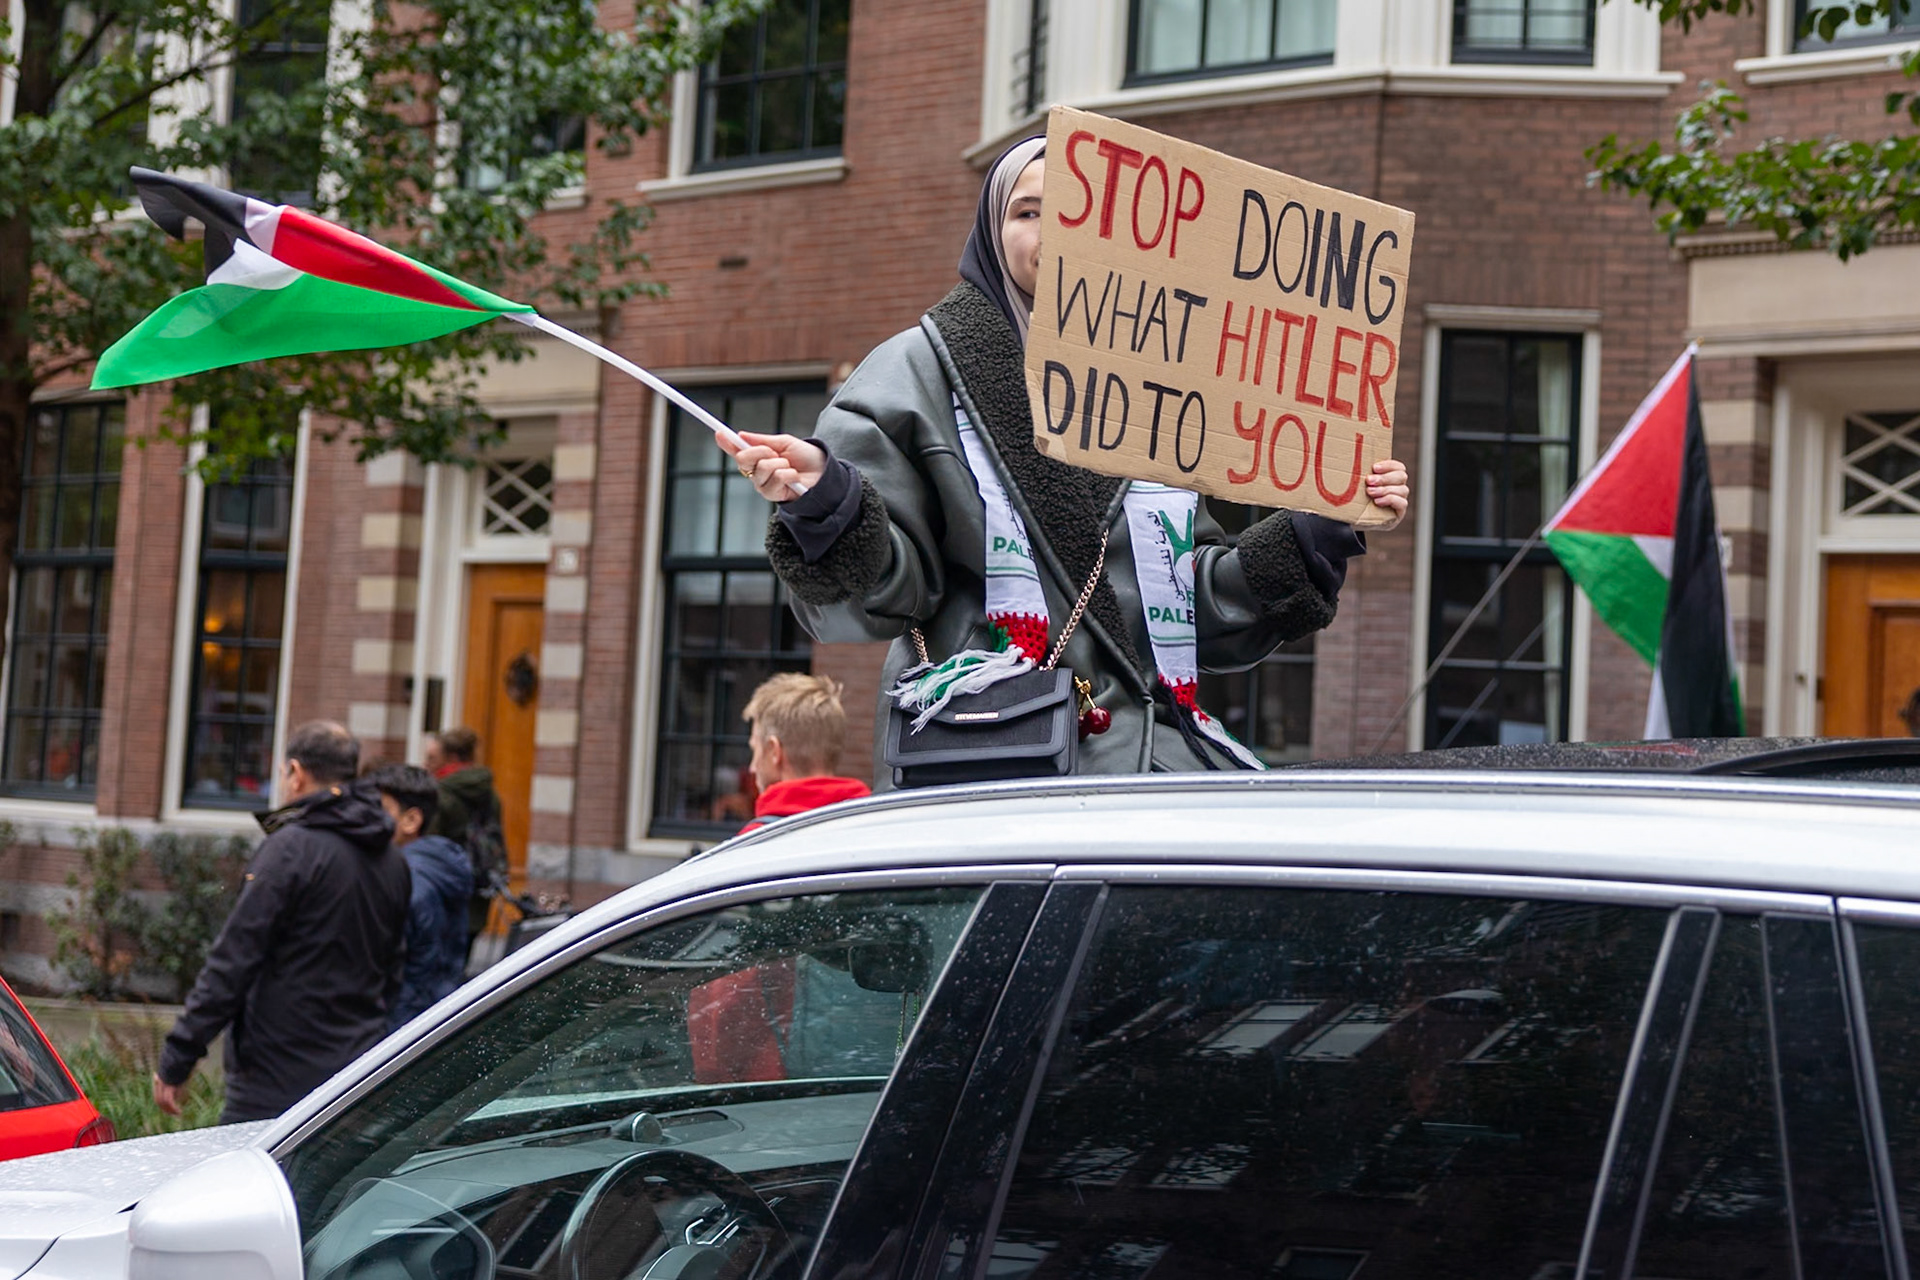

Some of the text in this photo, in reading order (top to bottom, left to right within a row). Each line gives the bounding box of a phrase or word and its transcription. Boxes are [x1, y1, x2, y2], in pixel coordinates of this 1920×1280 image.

[1058, 130, 1399, 325] STOP DOING
[1056, 256, 1398, 428] WHAT HITLER
[1043, 360, 1364, 507] DID TO YOU
